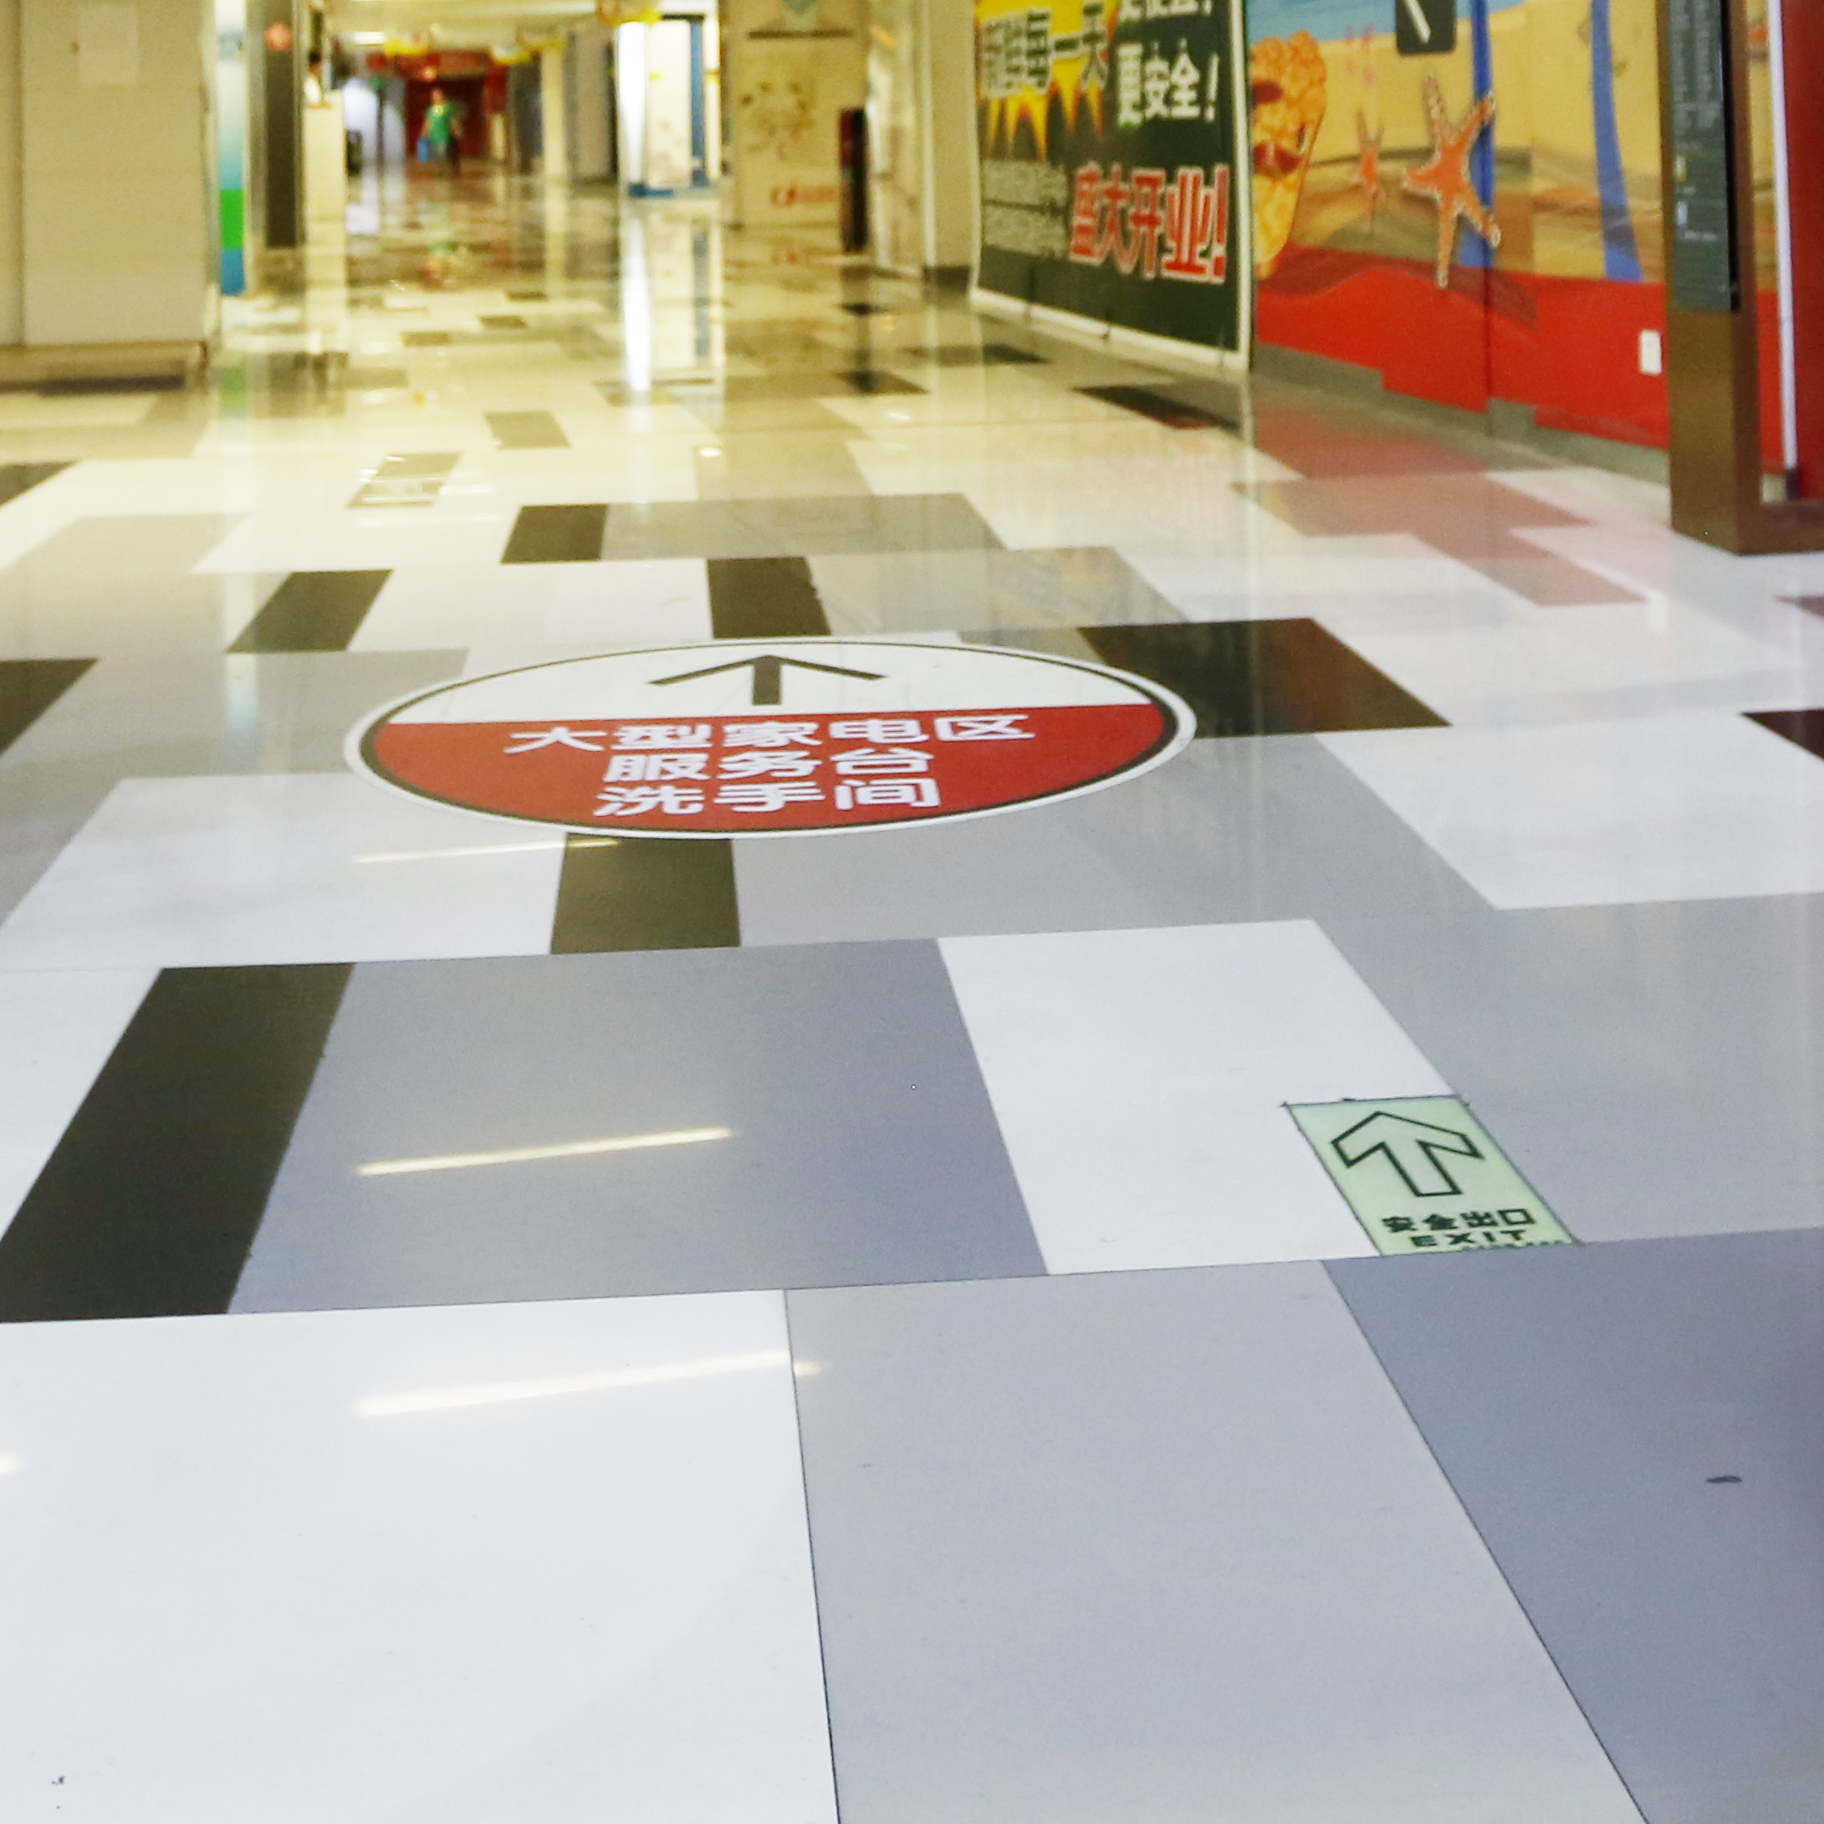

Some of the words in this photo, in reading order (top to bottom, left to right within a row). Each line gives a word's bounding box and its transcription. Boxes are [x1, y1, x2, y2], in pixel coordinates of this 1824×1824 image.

[503, 713, 1037, 754] 大型家电区
[601, 744, 934, 784] 服务台
[592, 777, 941, 818] 洗手间
[1382, 1207, 1536, 1234] 安全出口
[1409, 1229, 1527, 1248] EXIT
